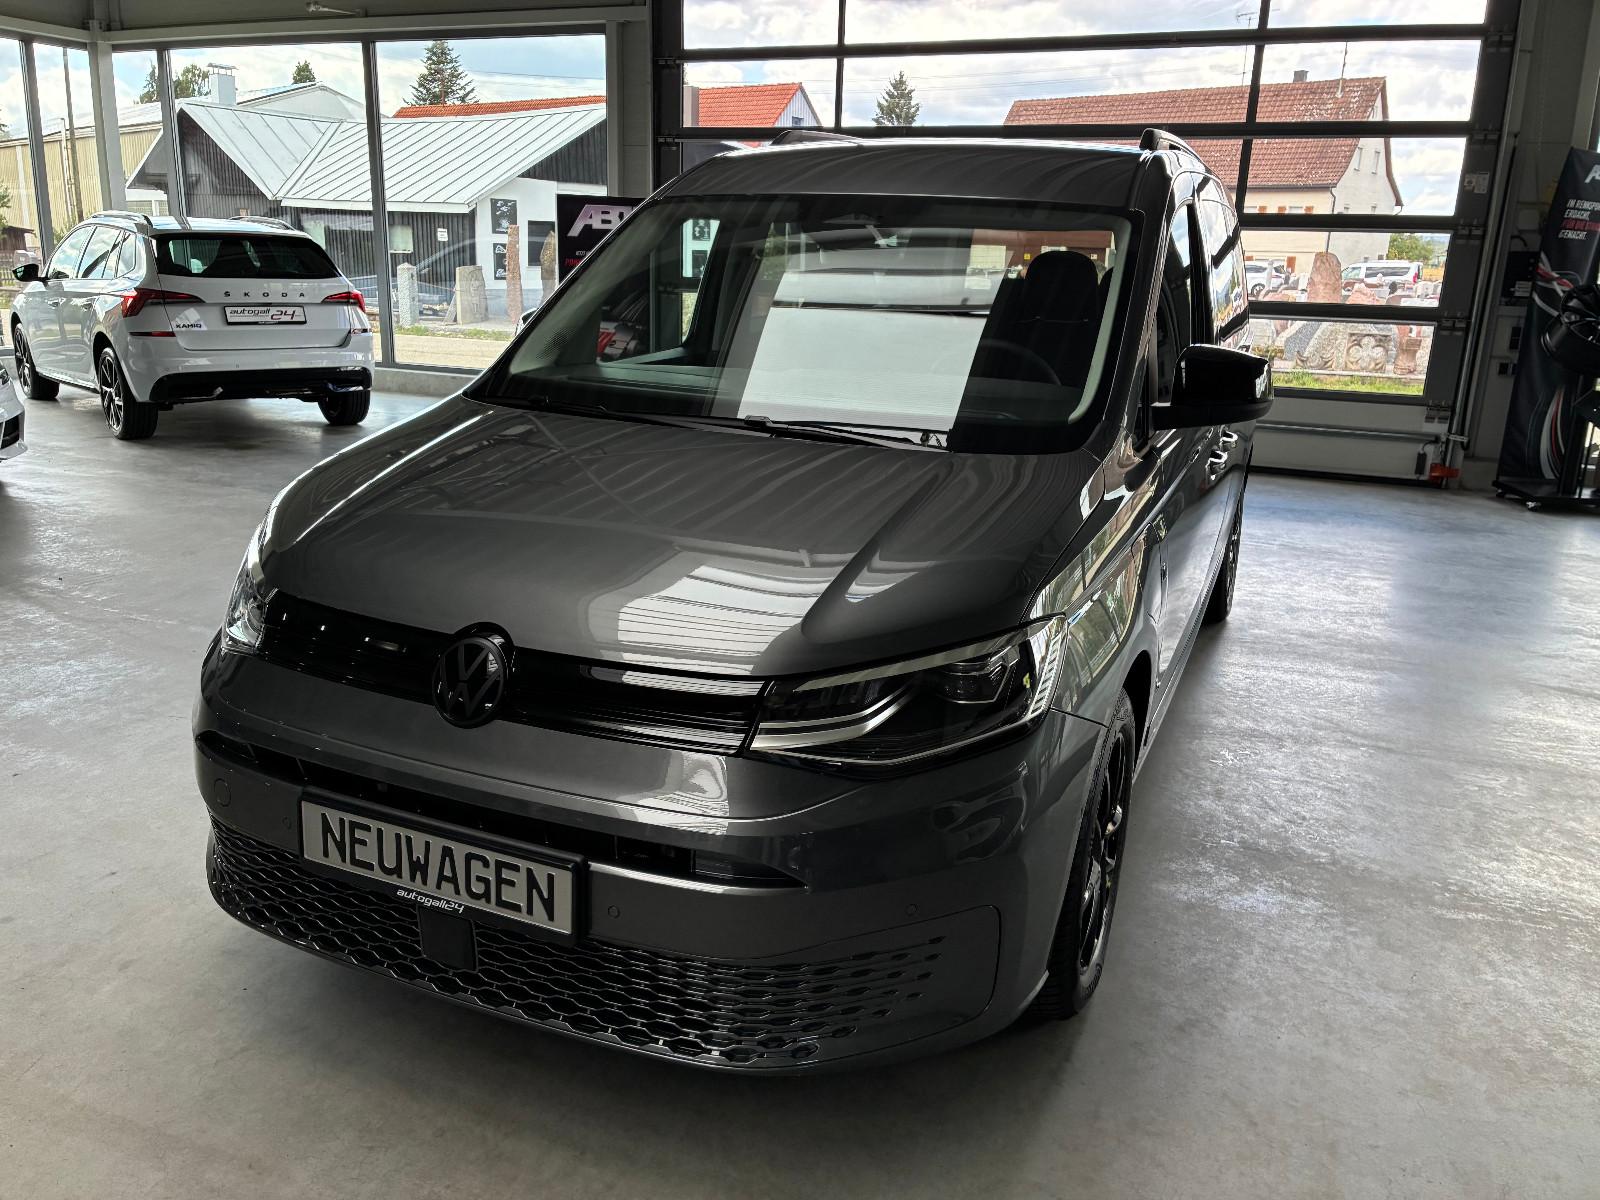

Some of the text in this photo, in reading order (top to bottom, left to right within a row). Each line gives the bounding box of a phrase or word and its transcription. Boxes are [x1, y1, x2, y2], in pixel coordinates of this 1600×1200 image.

[229, 308, 296, 321] autogall 24
[321, 812, 556, 922] NEUWAGEN
[396, 889, 465, 914] autogall24
